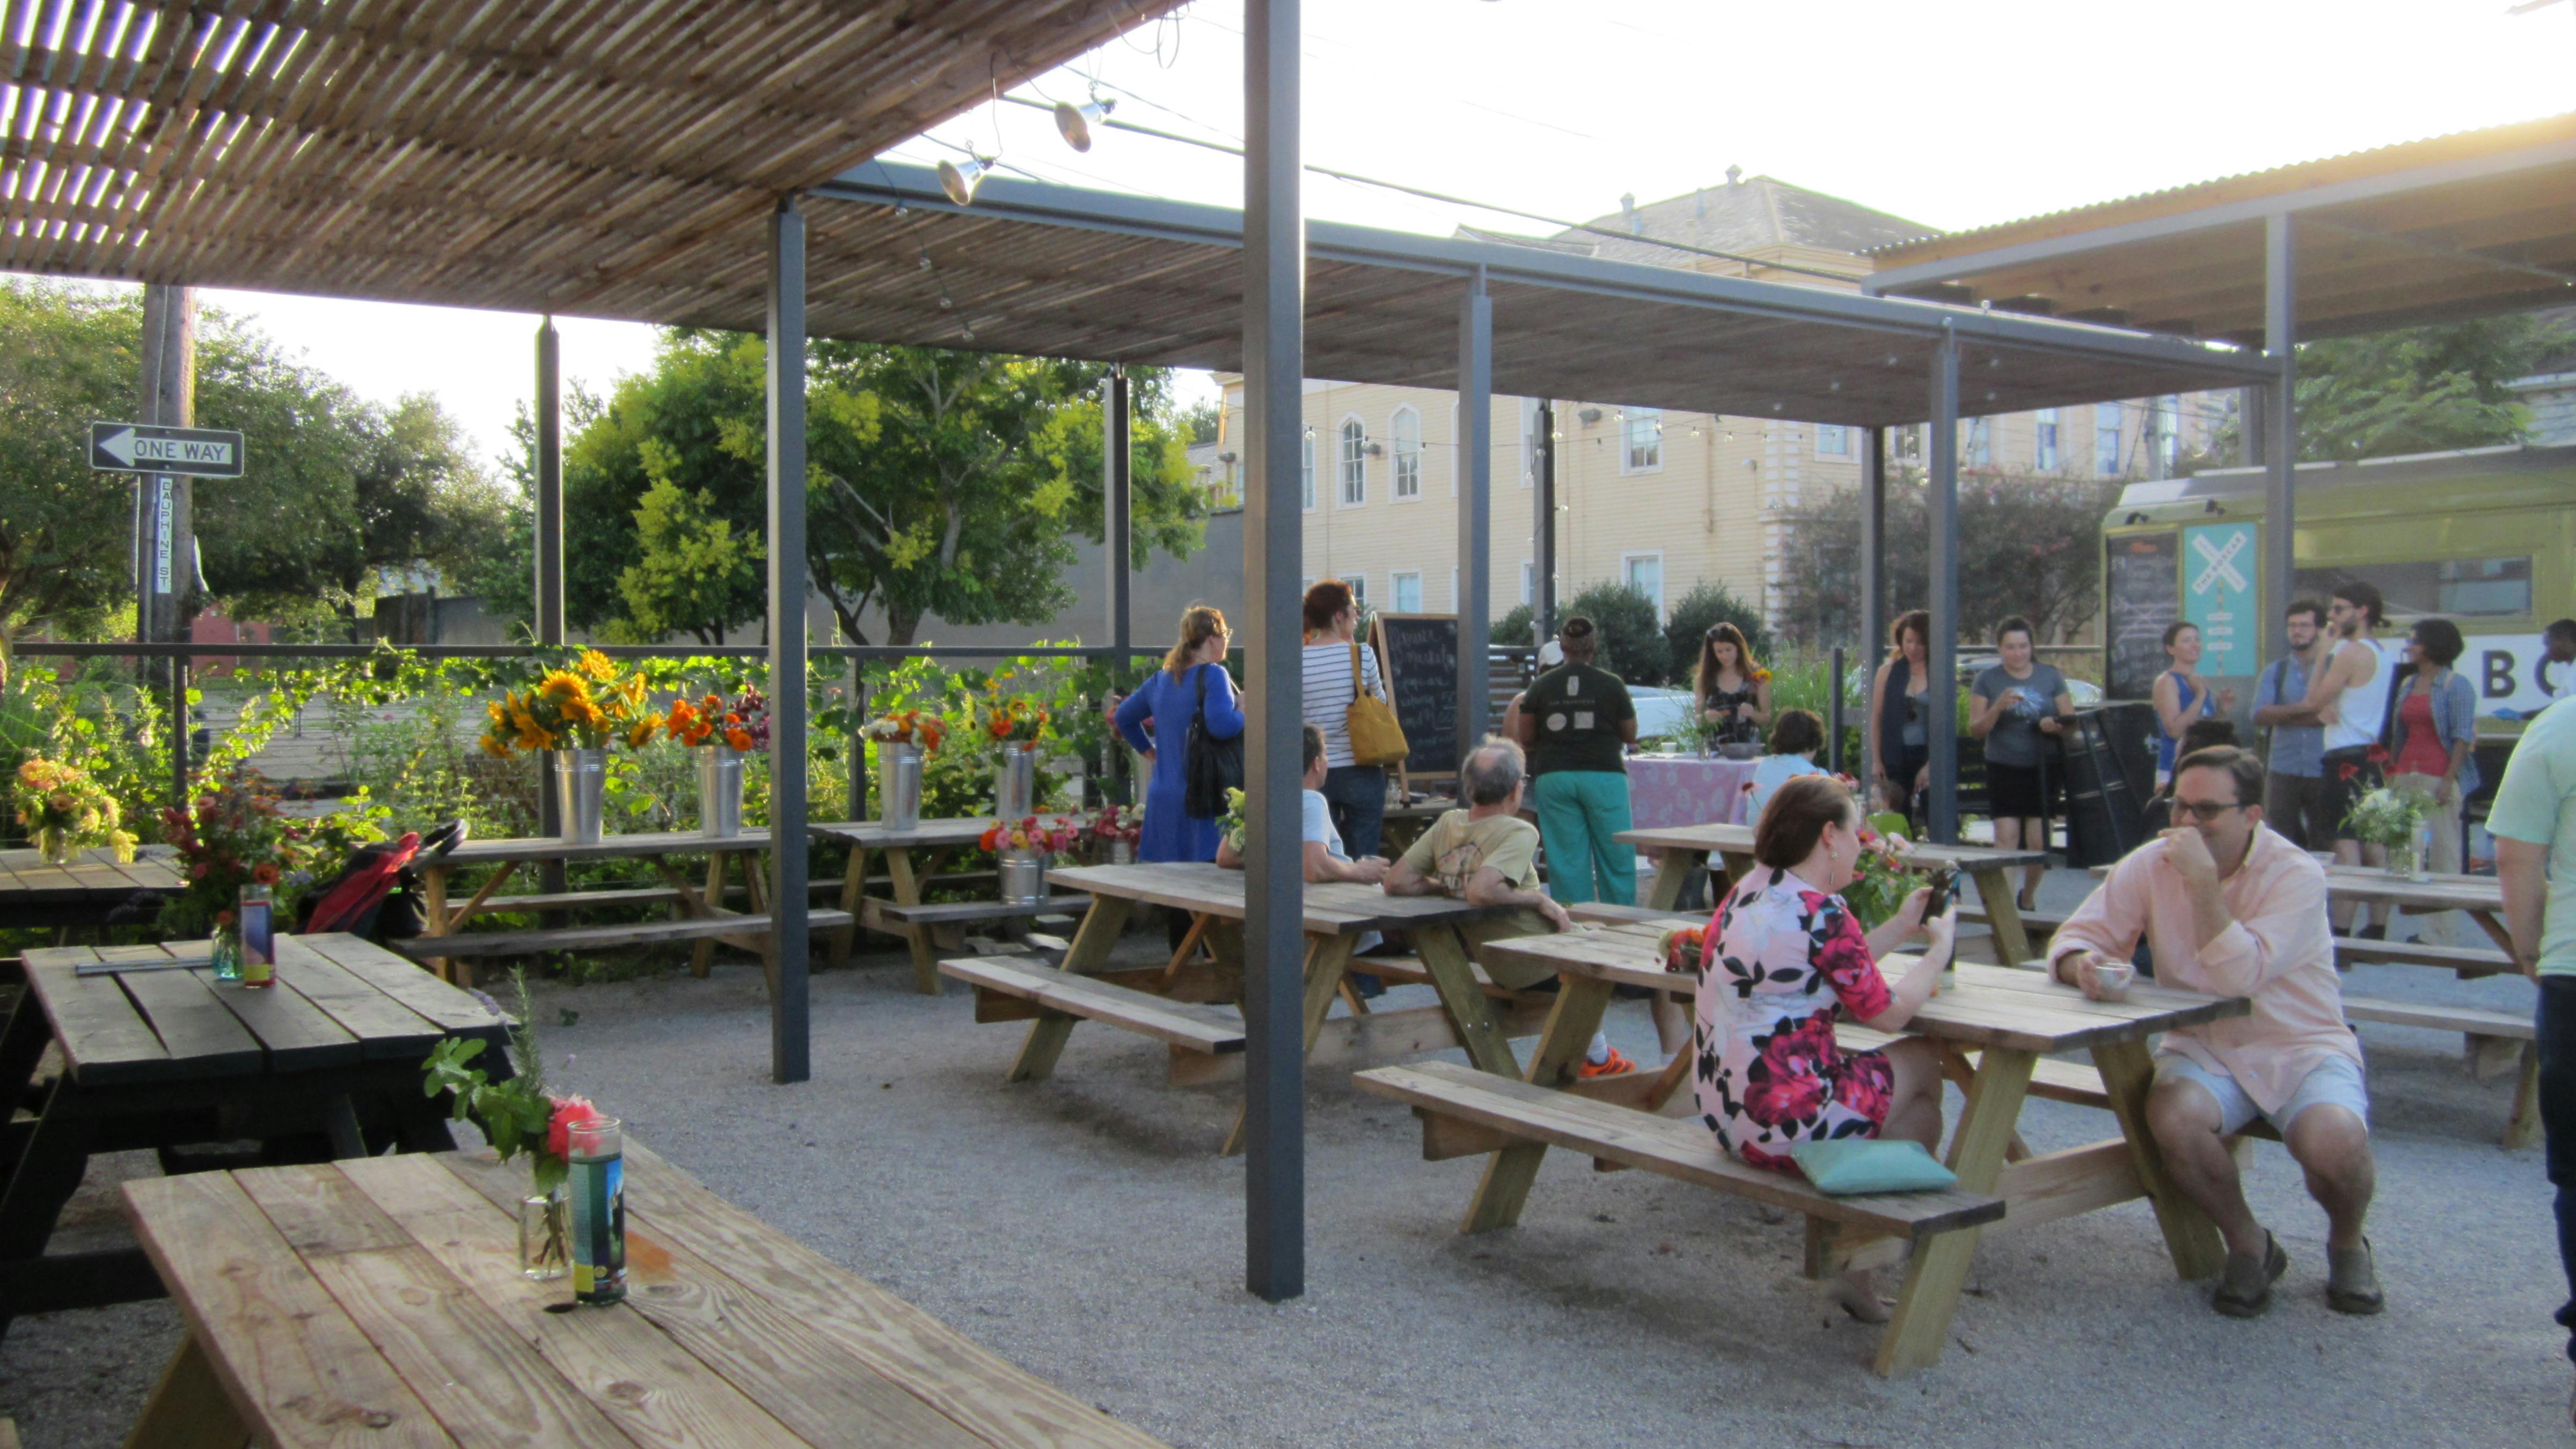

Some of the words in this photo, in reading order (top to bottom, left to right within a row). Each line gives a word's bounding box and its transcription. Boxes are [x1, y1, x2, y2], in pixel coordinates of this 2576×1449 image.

[135, 440, 177, 458] ONE
[185, 443, 225, 461] WAY
[160, 482, 171, 558] DAUPHINE
[160, 567, 169, 586] ST
[2196, 572, 2212, 589] THE
[2211, 536, 2242, 572] BOXCAR
